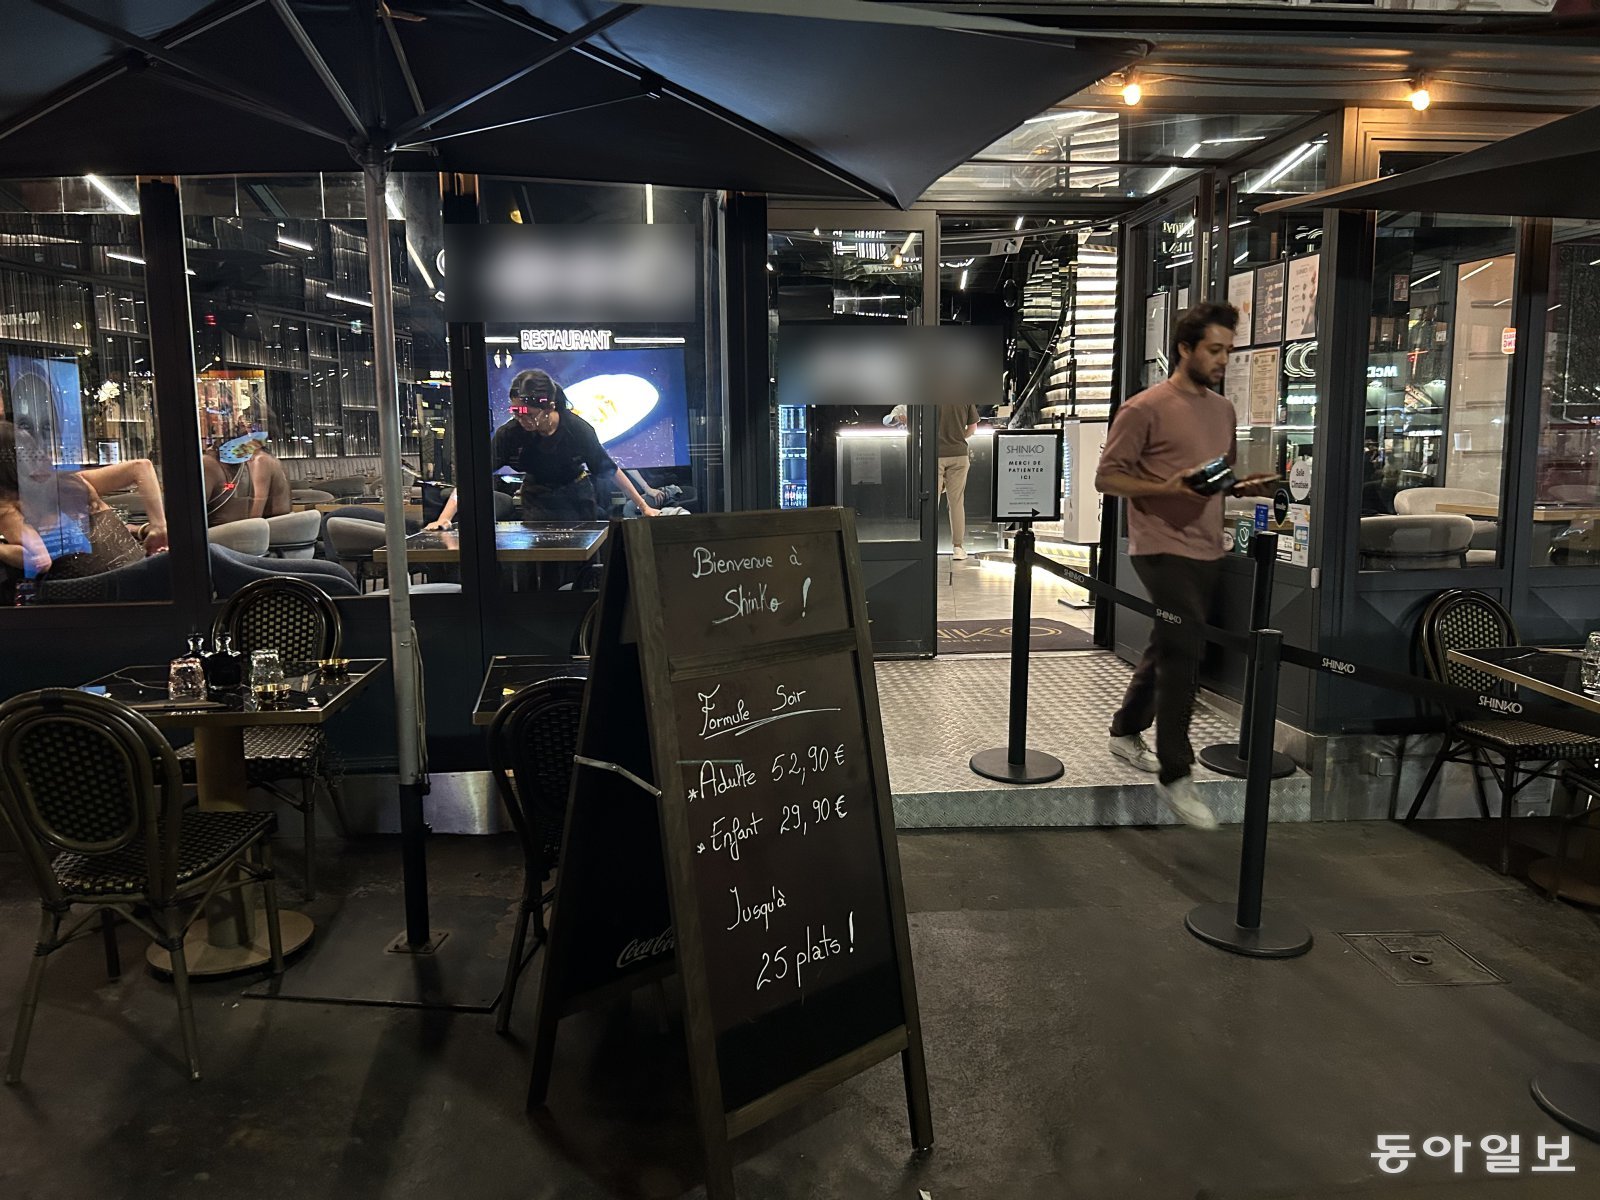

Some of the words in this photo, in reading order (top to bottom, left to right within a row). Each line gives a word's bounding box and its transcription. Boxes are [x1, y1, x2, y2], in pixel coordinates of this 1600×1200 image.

[520, 329, 612, 351] RESTAURANT
[1006, 444, 1045, 454] SHINKO
[692, 546, 774, 578] Bienvenue
[789, 545, 802, 566] à
[1063, 569, 1085, 583] SHINKO
[801, 577, 811, 618] !
[1156, 608, 1182, 624] SHINKO
[1322, 657, 1356, 674] SHINKO
[698, 684, 750, 736] Formule
[771, 684, 806, 712] Soir
[1478, 695, 1523, 714] SHINKO
[727, 886, 787, 932] Jusqu'à
[756, 946, 788, 990] 25
